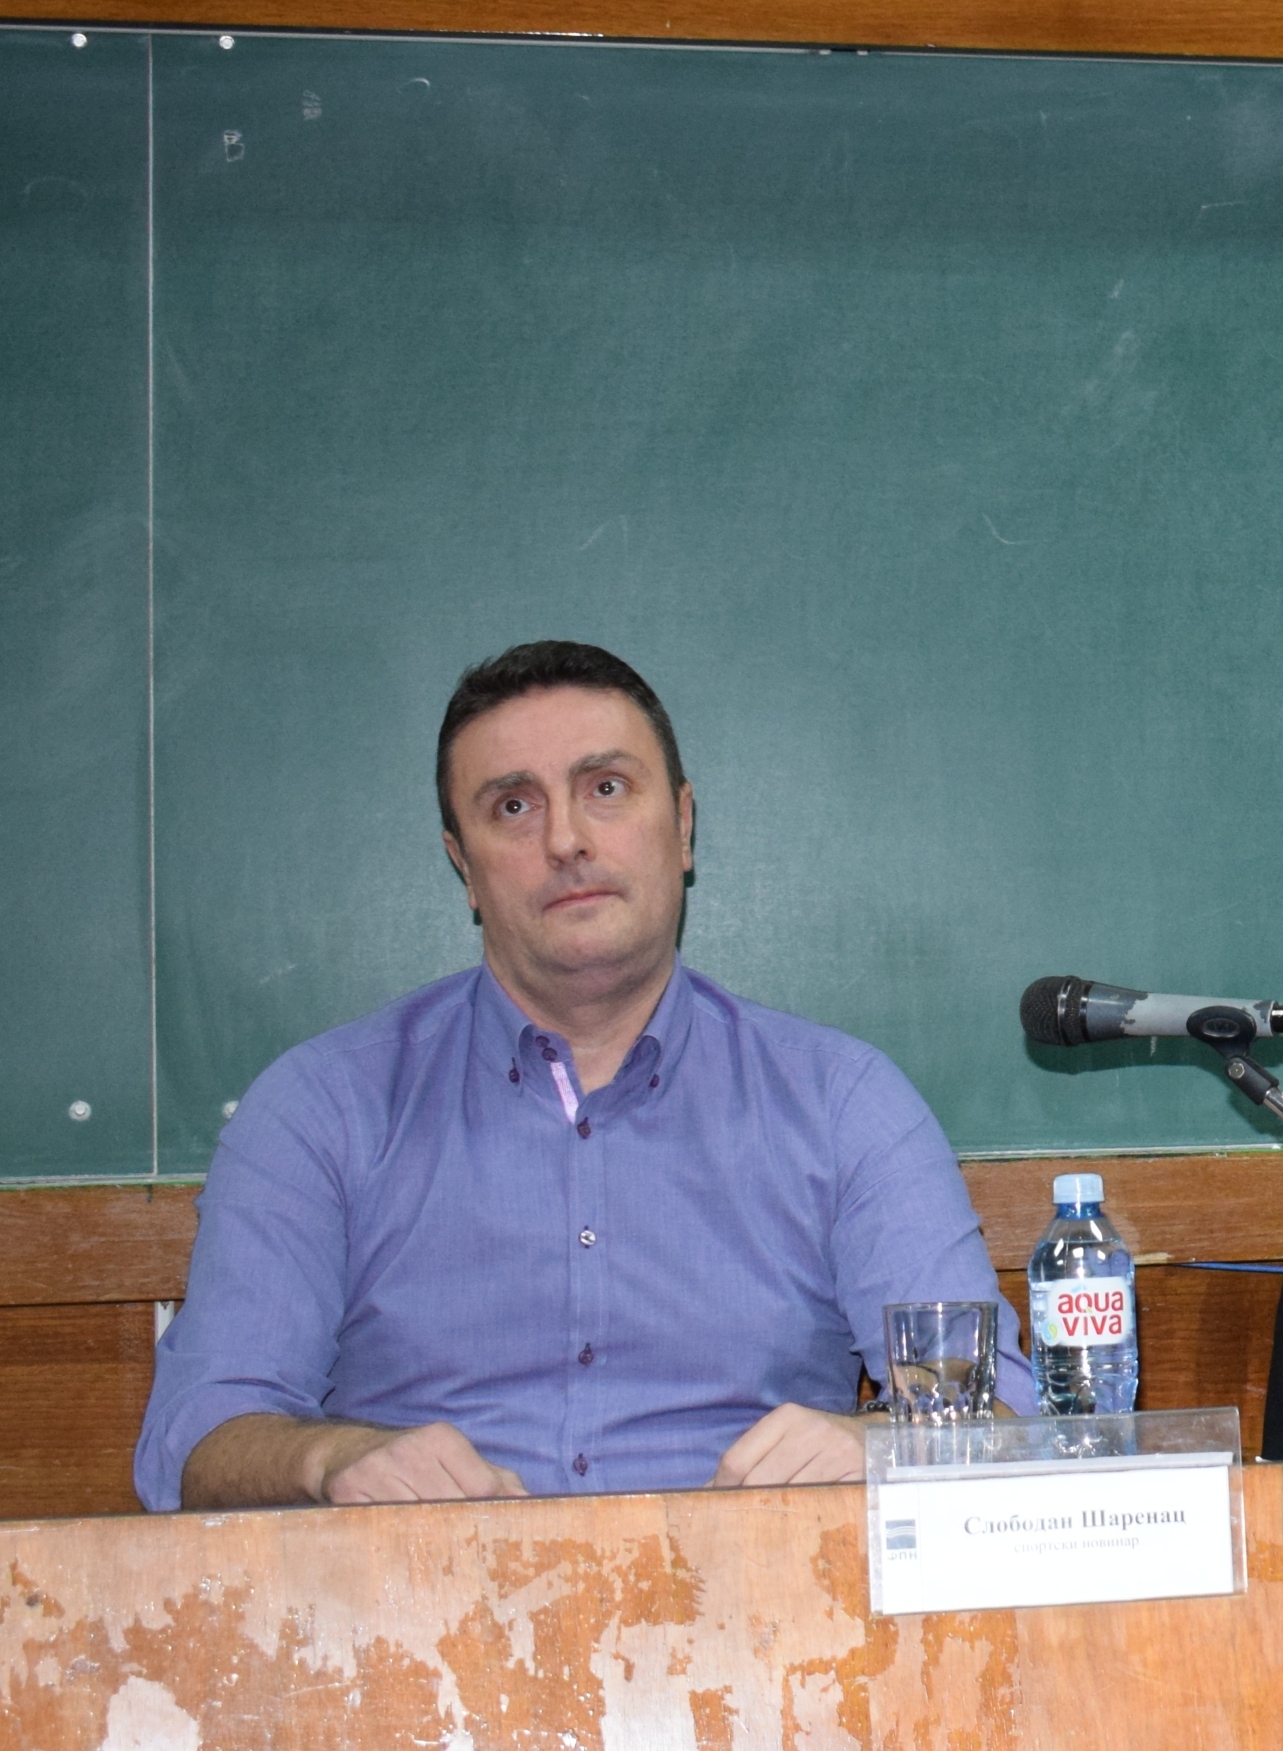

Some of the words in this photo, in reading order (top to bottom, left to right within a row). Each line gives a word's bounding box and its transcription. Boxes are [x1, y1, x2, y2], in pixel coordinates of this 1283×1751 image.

[1058, 1291, 1123, 1314] aqua
[1062, 1314, 1122, 1336] viva
[963, 1513, 1073, 1536] Слободан
[1081, 1507, 1187, 1531] Шаренац
[887, 1551, 918, 1561] ФПН
[1013, 1540, 1078, 1555] спортски
[1082, 1536, 1140, 1550] новинар
